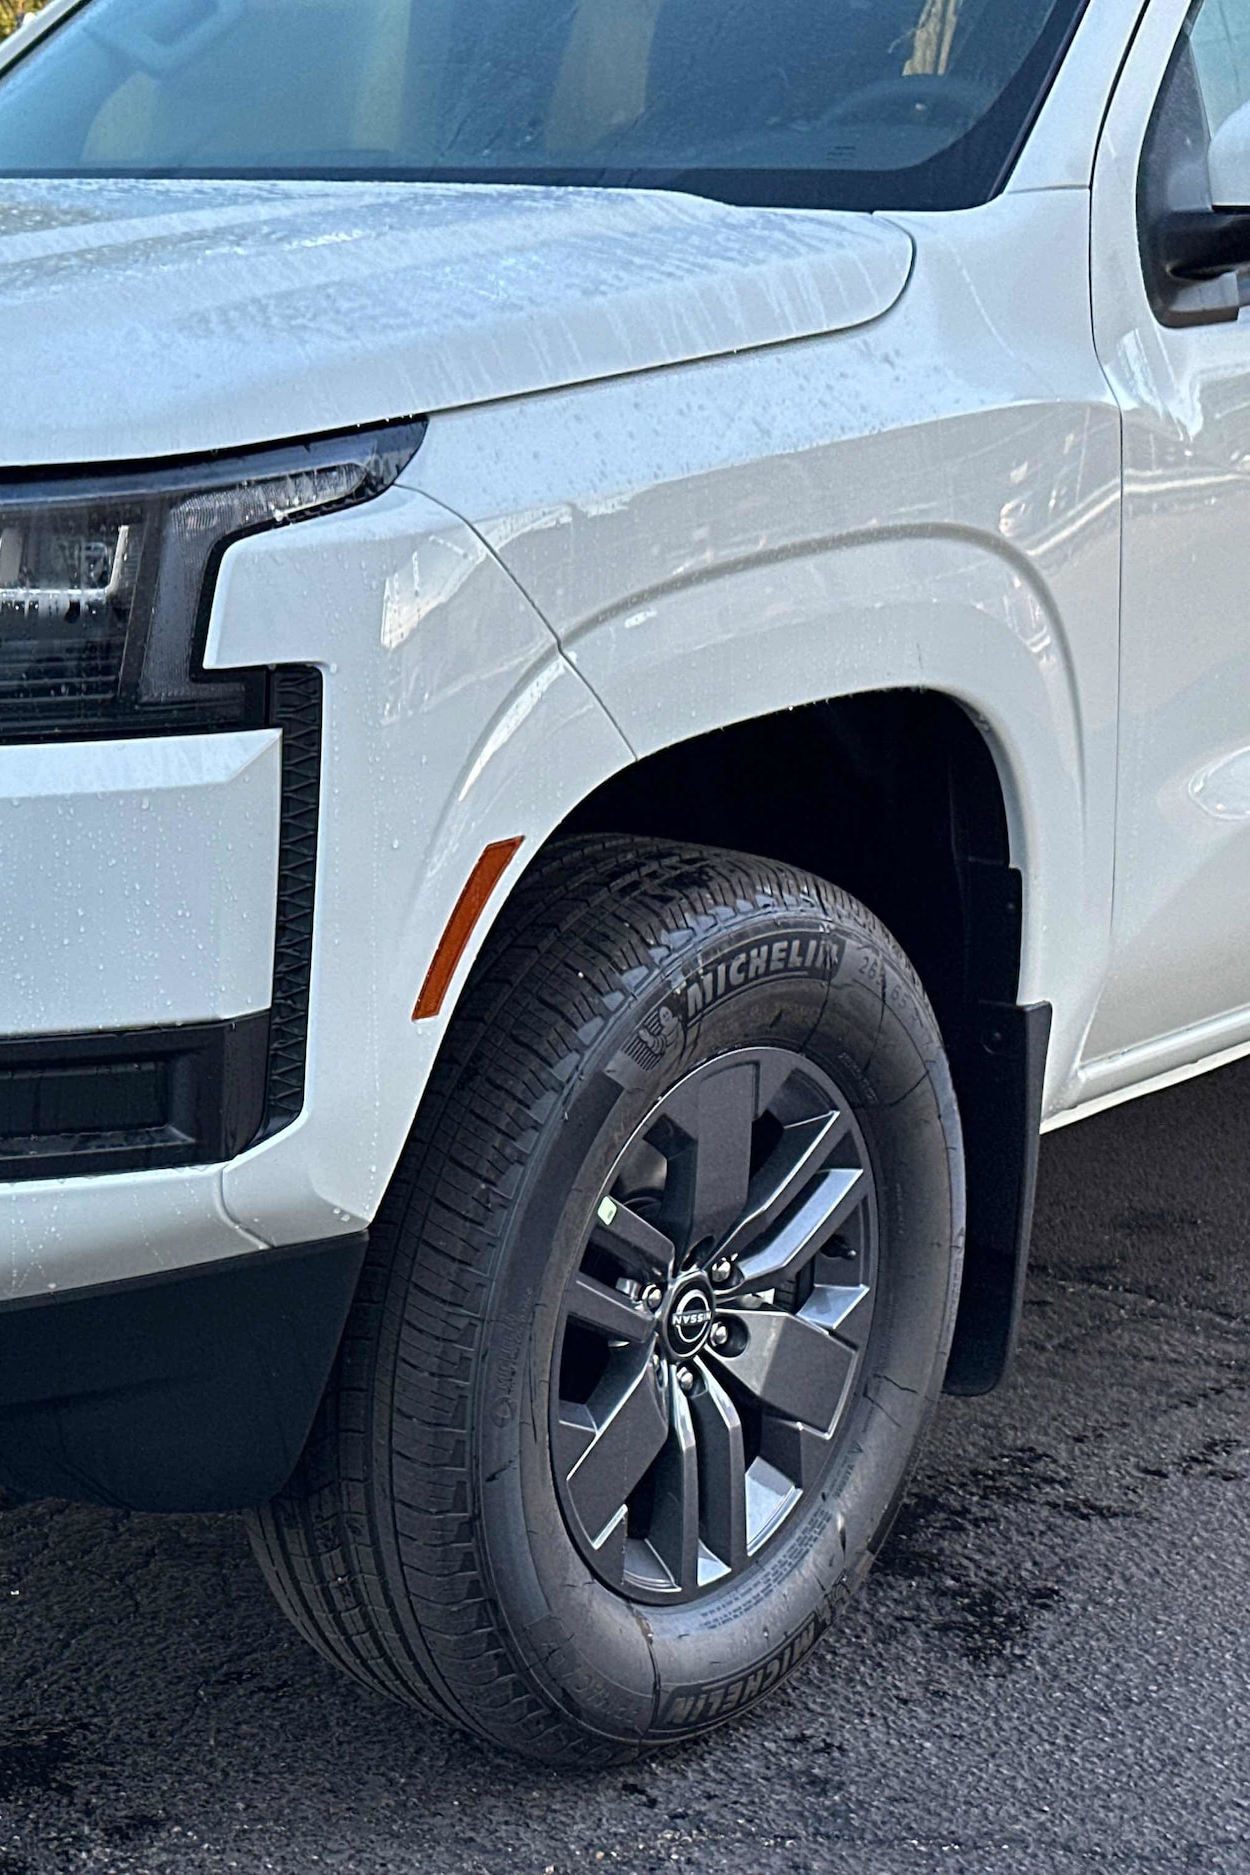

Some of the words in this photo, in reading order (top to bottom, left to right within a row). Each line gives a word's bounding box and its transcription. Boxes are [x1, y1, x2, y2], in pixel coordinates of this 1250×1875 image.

[686, 939, 840, 1018] MICHELIN
[672, 1311, 712, 1325] NISSAN
[671, 1621, 816, 1724] MICHELIN
